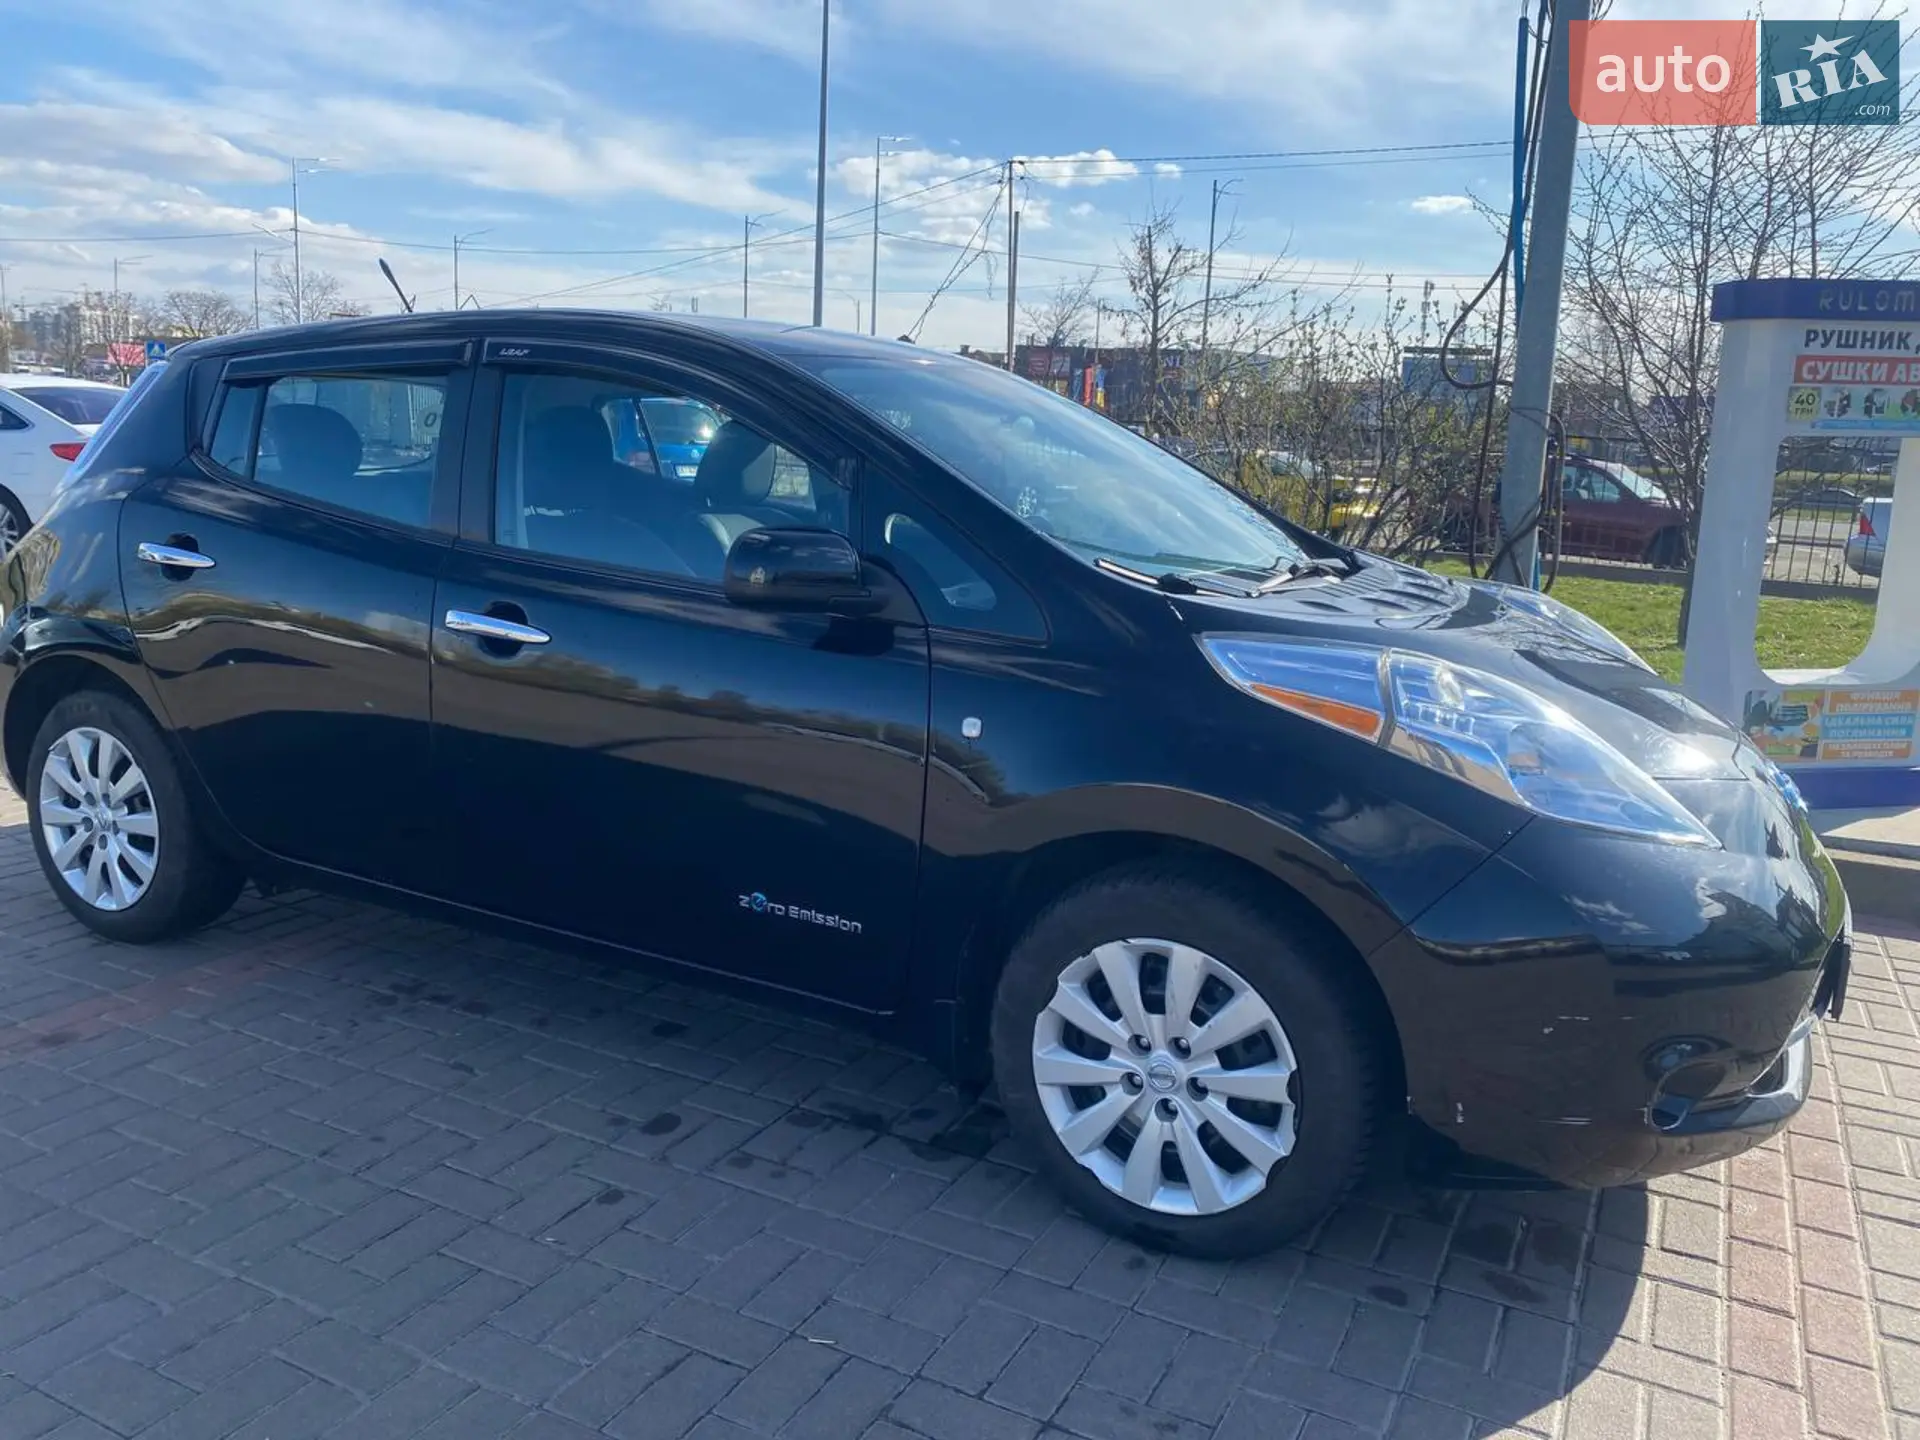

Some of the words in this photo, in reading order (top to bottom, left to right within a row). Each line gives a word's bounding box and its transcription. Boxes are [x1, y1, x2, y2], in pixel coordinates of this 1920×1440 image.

[1804, 329, 1913, 350] РУШНИК
[1802, 360, 1889, 382] СУШКИ
[1795, 393, 1816, 406] 40
[788, 905, 862, 934] Emission
